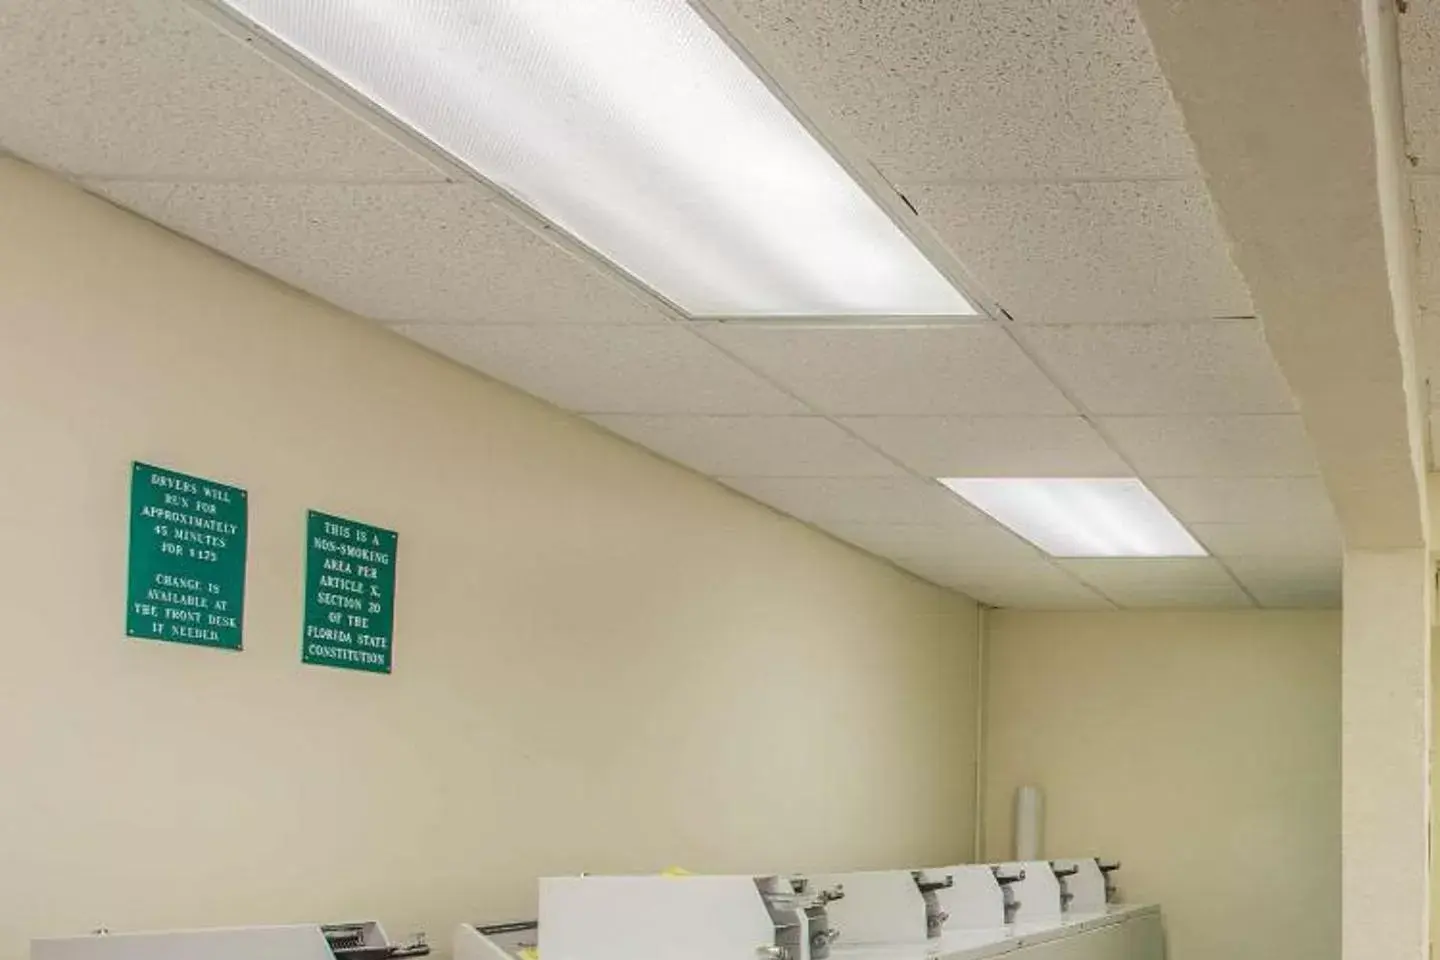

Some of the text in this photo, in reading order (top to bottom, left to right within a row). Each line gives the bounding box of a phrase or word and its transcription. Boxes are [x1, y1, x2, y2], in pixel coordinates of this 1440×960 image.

[151, 474, 231, 503] DRYERS WILL
[164, 493, 217, 514] RUN FOR
[140, 505, 238, 534] APPROXIMATELY
[154, 525, 226, 548] 45 MINUTES
[324, 521, 380, 546] THIS IS A
[161, 542, 183, 556] FOR
[313, 536, 389, 565] NON-SMOKING
[323, 558, 377, 579] AREA PER
[155, 573, 220, 594] CHANGE IS
[320, 575, 364, 594] ARTICLE
[147, 588, 228, 611] AVAILABLE AT
[317, 592, 381, 613] SECTION 20
[134, 602, 237, 628] THE FRONT DESK
[328, 611, 369, 628] OF THE
[152, 621, 164, 633] IF
[307, 625, 388, 648] FLORIDA STATE
[308, 644, 385, 666] CONSTITUTION
